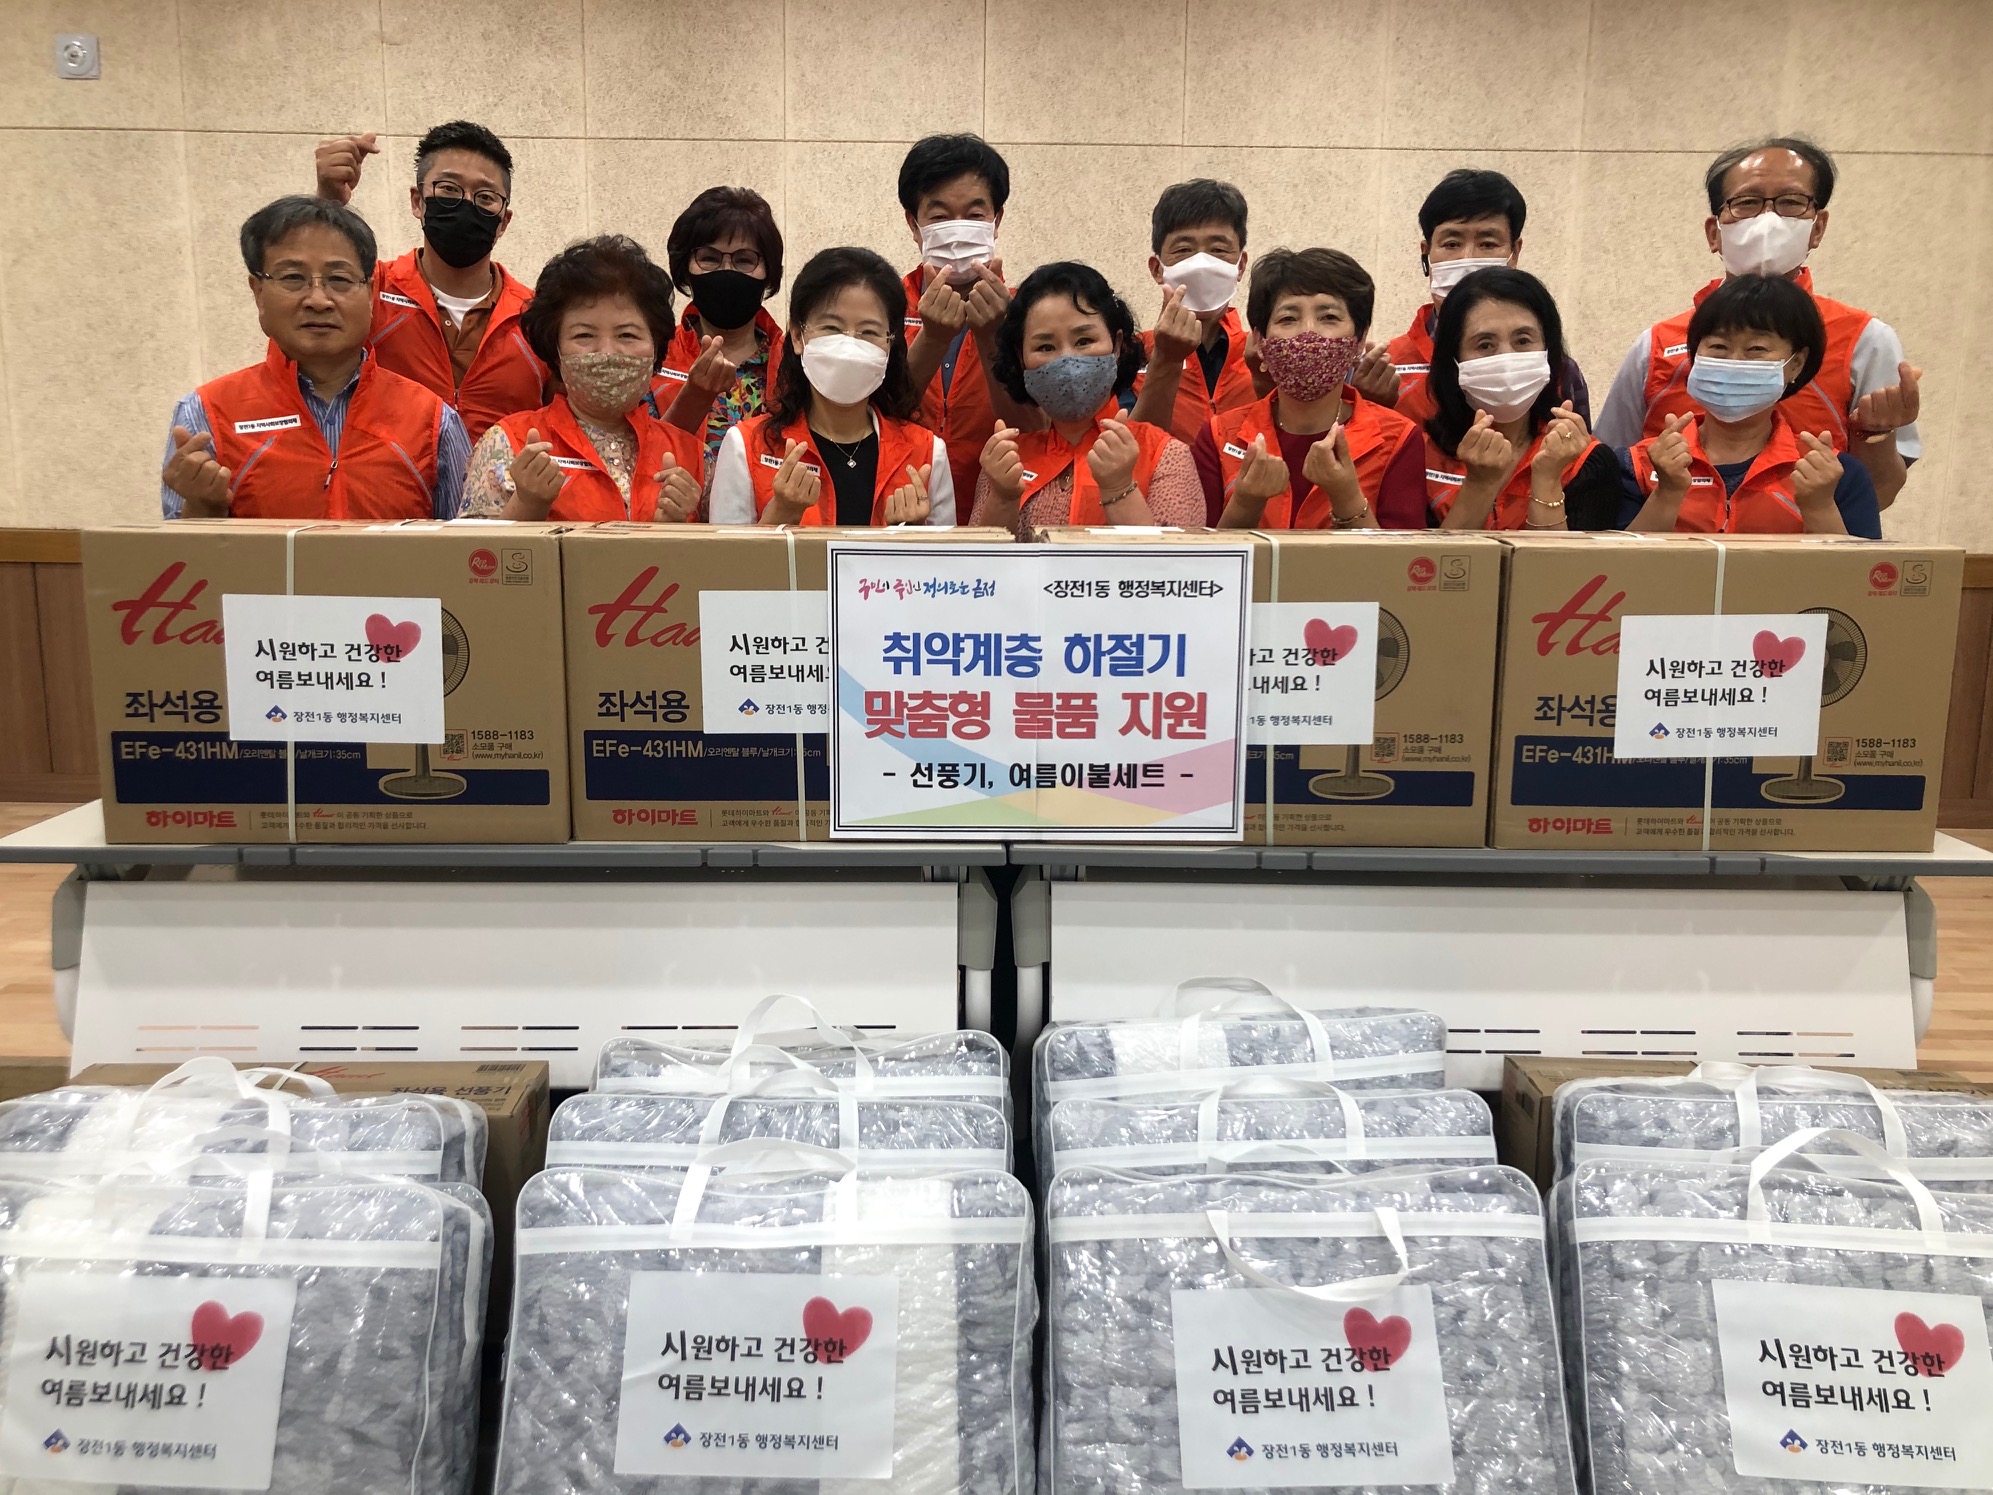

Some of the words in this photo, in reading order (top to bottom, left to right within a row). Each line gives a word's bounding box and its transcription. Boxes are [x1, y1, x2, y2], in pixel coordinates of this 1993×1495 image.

[1118, 580, 1224, 598] 행정복지센터>
[111, 561, 225, 645] Ha
[255, 638, 337, 661] 시원하고
[344, 643, 403, 663] 건강한
[729, 633, 808, 655] 시원하고
[882, 631, 1042, 678] 취약계층
[1063, 633, 1187, 678] 하절기
[1282, 648, 1338, 667] 건강한
[1646, 657, 1723, 679] 시원하고
[1731, 659, 1786, 678] 건강한
[1248, 676, 1308, 694] 내세요
[125, 690, 223, 724] 좌석용
[597, 690, 690, 722] 좌석용
[765, 704, 804, 715] 장전1동
[863, 690, 991, 740] 맞춤형
[1012, 691, 1100, 740] 물품
[1118, 691, 1208, 740] 지원
[293, 711, 333, 723] 장전1동
[336, 712, 402, 724] 행정복지센터
[1269, 715, 1333, 726] 행정복지센터
[471, 730, 534, 740] 1588-1183
[1402, 734, 1464, 744] 1588-1183
[1675, 727, 1713, 738] 장전1동
[1716, 726, 1778, 738] 행정복지센터
[497, 743, 513, 751] 구매
[1856, 738, 1917, 748] 1588-1183
[910, 762, 994, 789] 선풍기,
[1008, 762, 1166, 789] 여름이불세트
[146, 810, 237, 828] 하이마트
[612, 808, 698, 827] 하이마트
[1527, 817, 1613, 835] 하이마트
[46, 1334, 147, 1369] 시원하고
[157, 1340, 235, 1371] 건강한
[661, 1329, 764, 1362] 시원하고
[774, 1335, 848, 1364] 건강한
[1212, 1345, 1312, 1375] 시원하고
[1321, 1347, 1392, 1373] 건강한
[1758, 1338, 1864, 1371] 시원하고
[1872, 1349, 1946, 1378] 건강한
[699, 1431, 750, 1449] 장전1동
[755, 1433, 839, 1450] 행정복지센터
[1815, 1438, 1868, 1457] 장전1동
[1872, 1442, 1957, 1462] 행정복지센터
[1261, 1443, 1312, 1460] 장전1동
[1316, 1441, 1399, 1459] 행정복지센터
